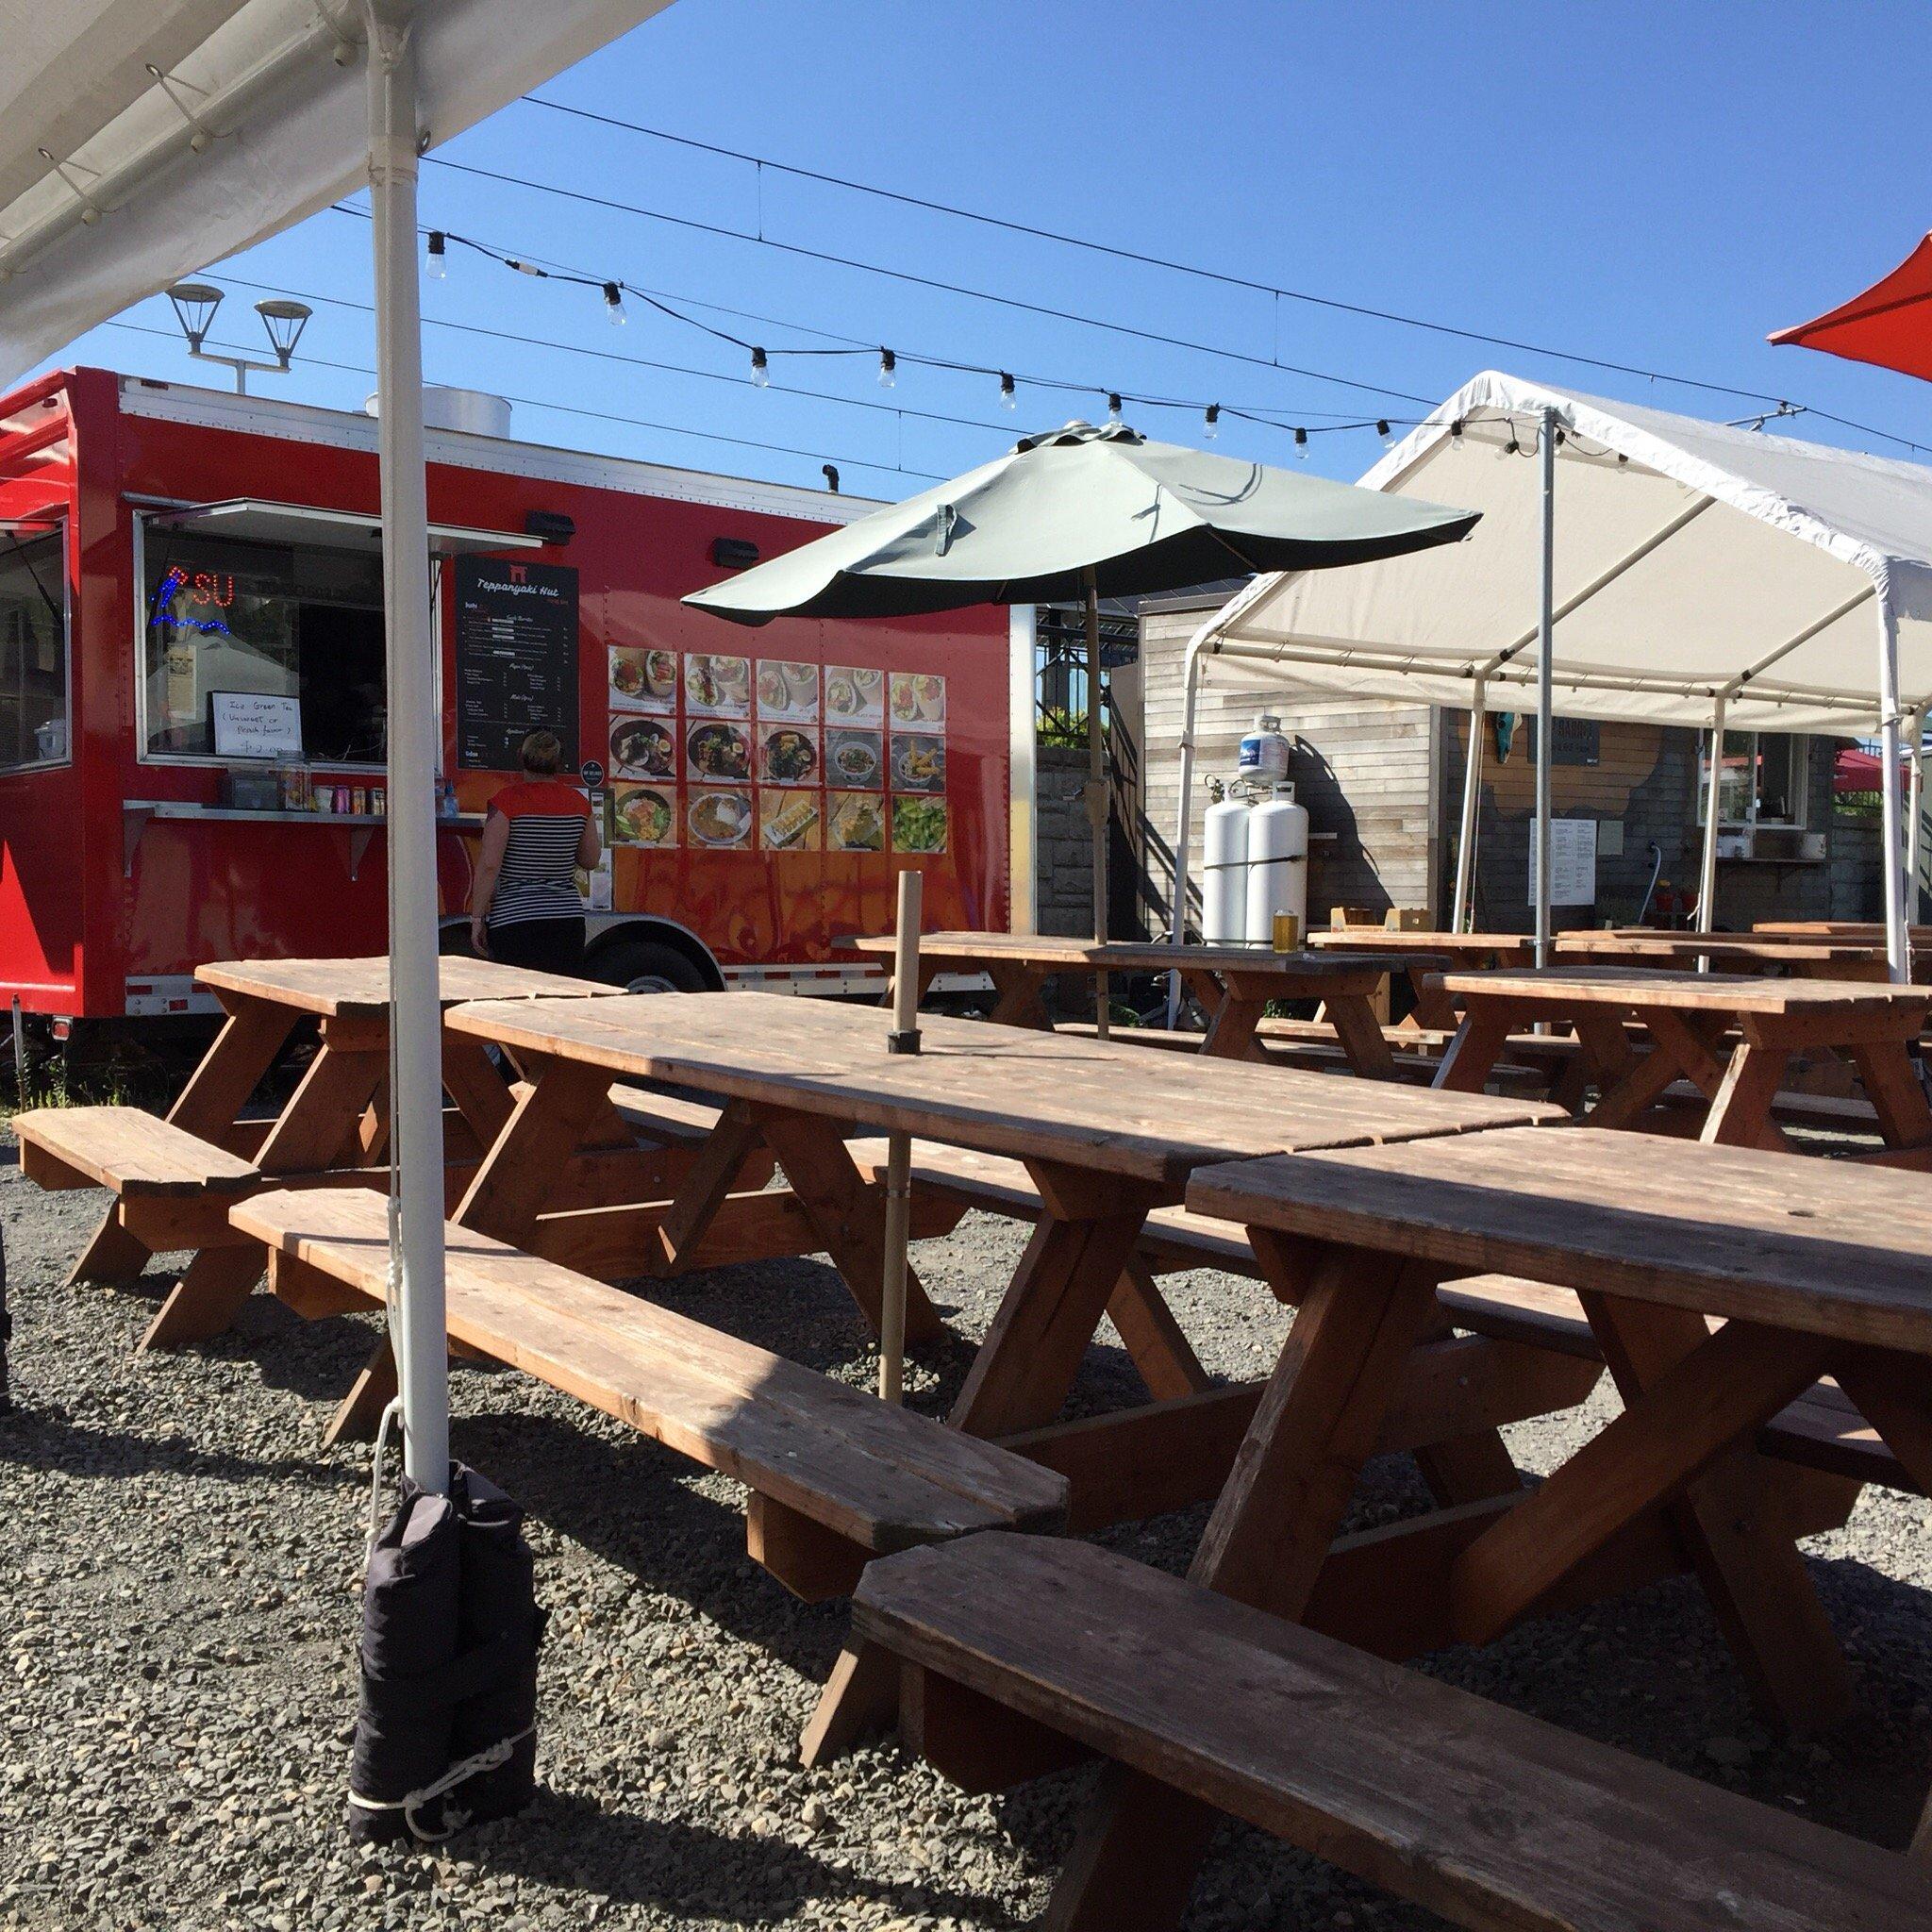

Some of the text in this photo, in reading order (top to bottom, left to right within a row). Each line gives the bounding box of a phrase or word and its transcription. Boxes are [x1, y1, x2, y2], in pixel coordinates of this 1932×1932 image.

[475, 577, 560, 597] Teppanyaki Hut
[229, 700, 293, 711] Ice Green Tea
